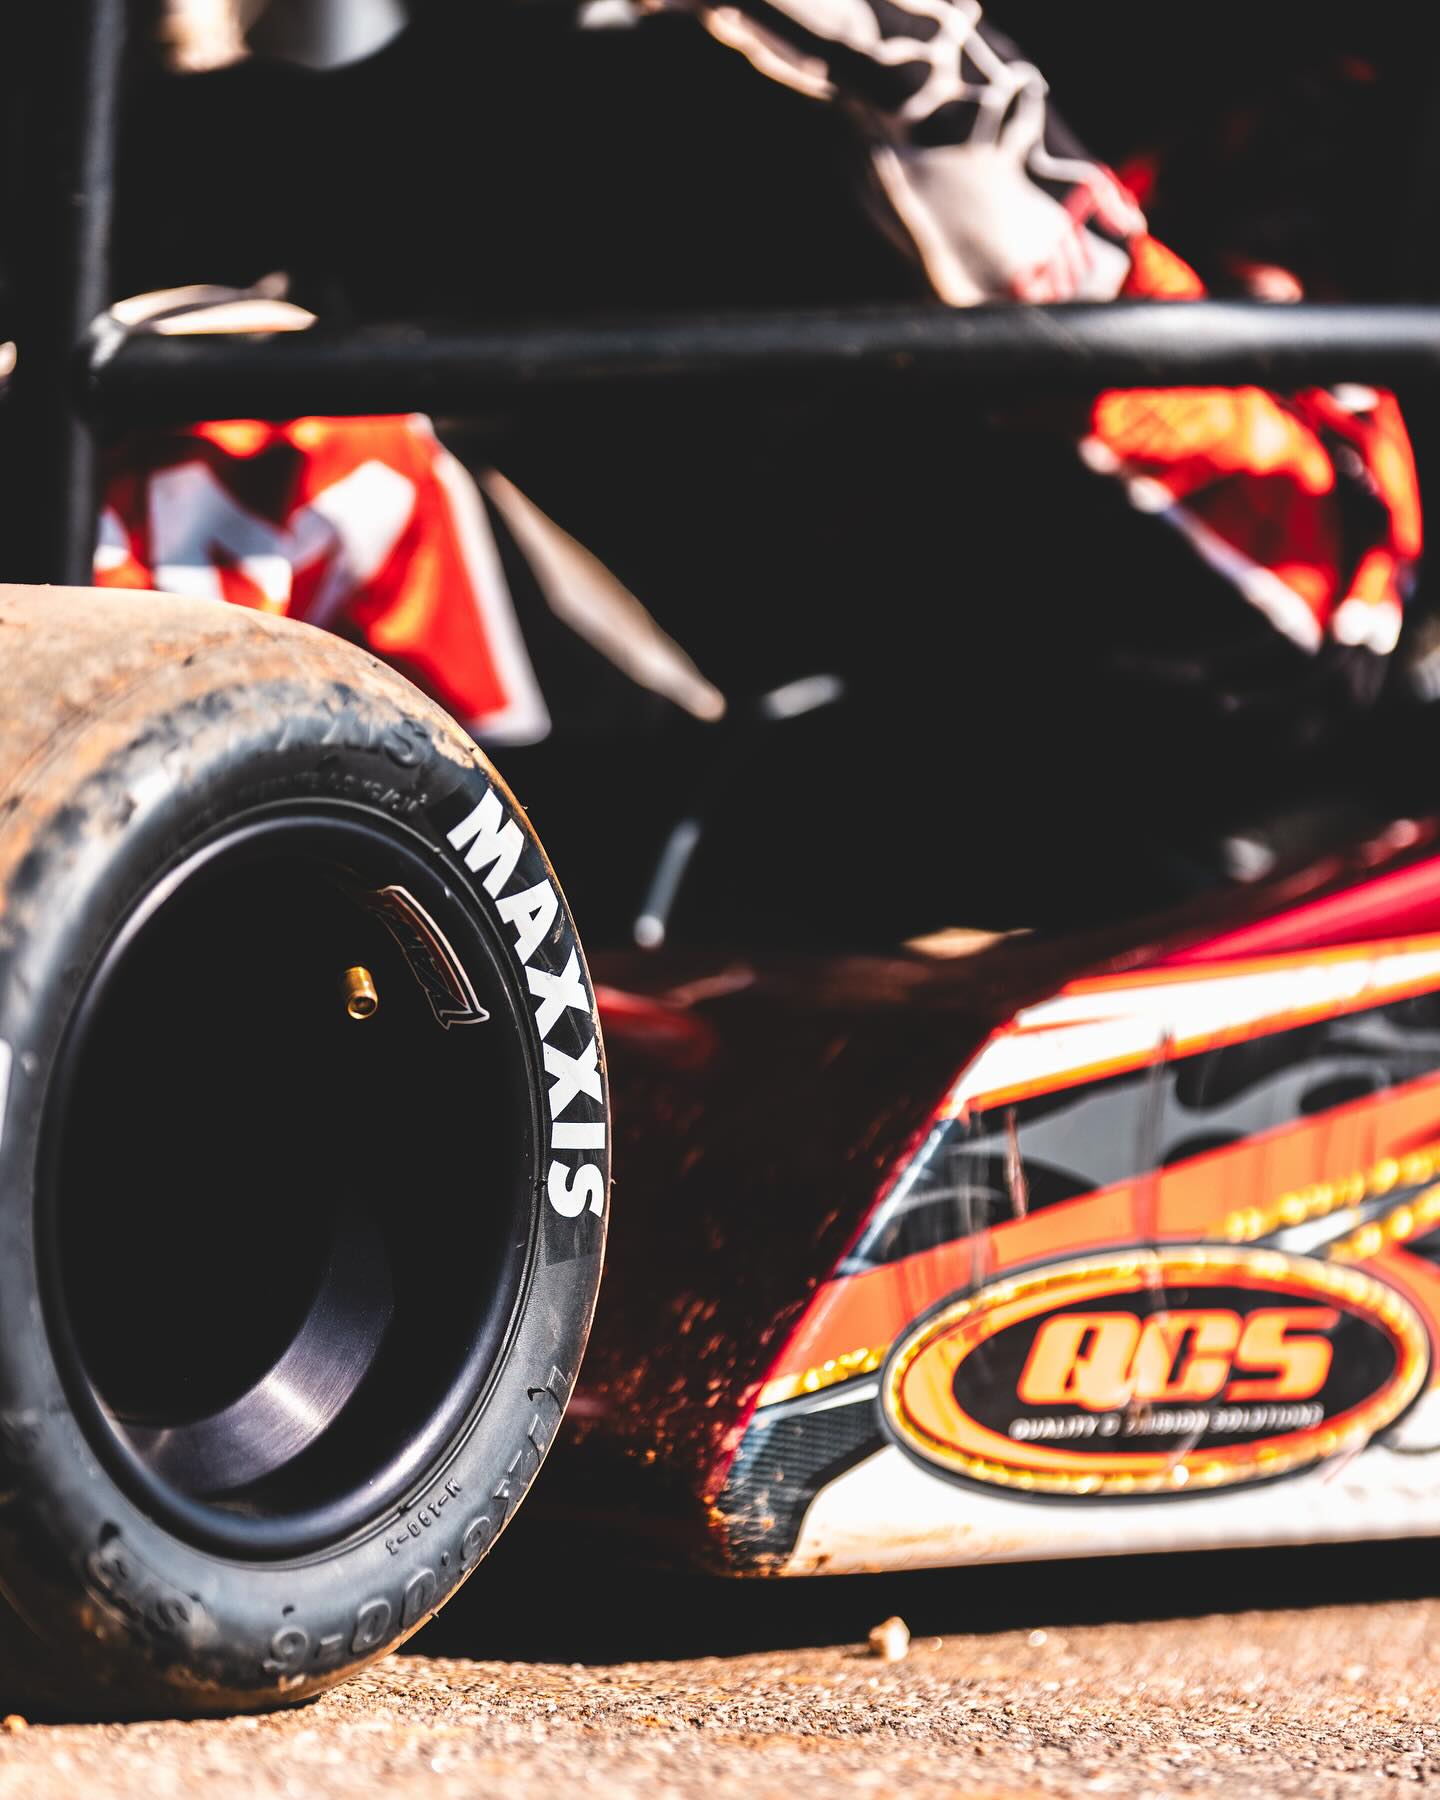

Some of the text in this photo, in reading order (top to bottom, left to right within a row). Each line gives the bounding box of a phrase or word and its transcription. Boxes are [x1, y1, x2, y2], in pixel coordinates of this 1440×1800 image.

[446, 788, 605, 1218] MAXXIS
[1016, 1306, 1340, 1413] QCS
[386, 1479, 461, 1556] M-190-3
